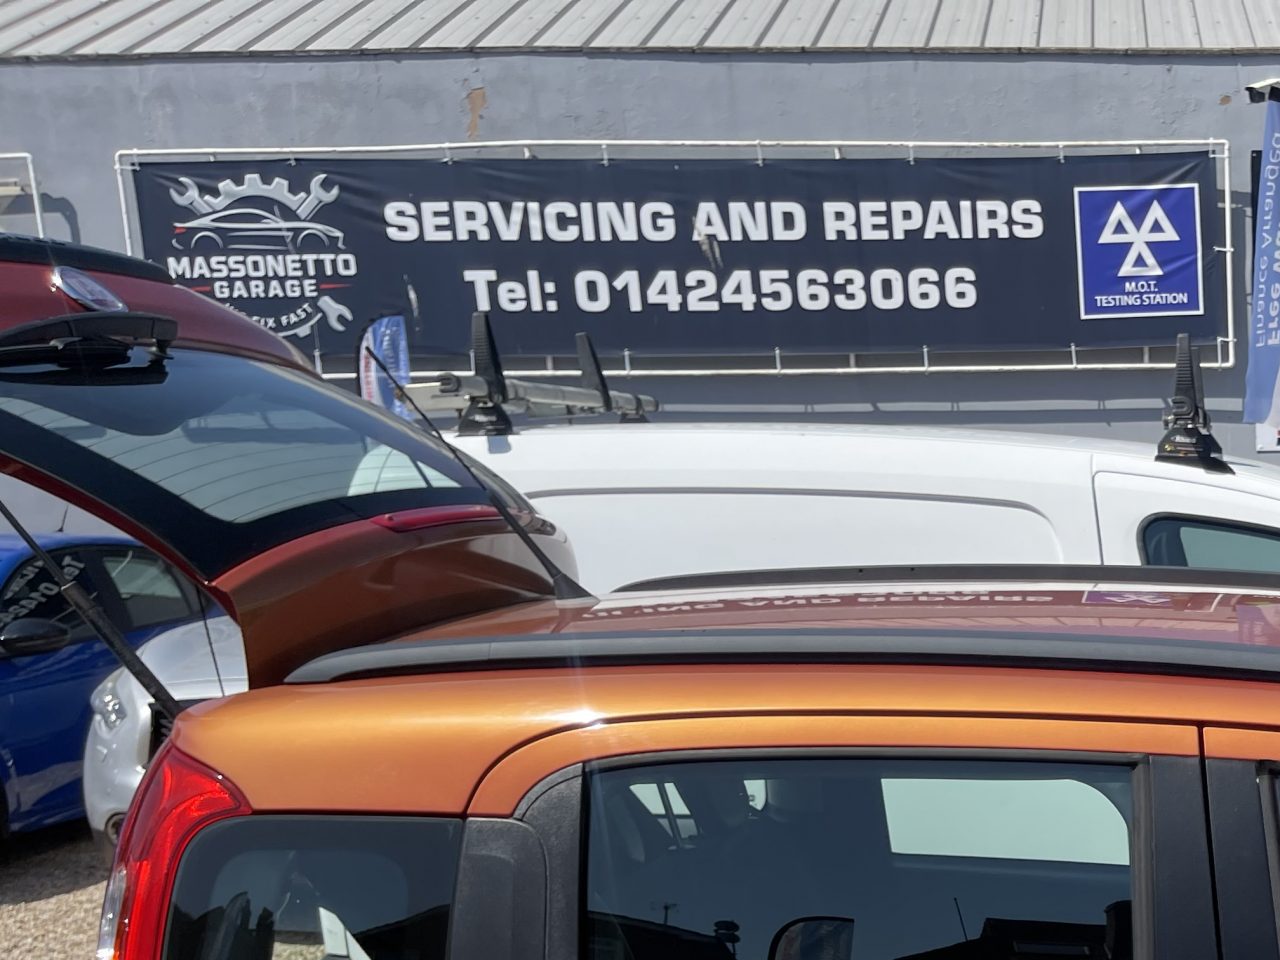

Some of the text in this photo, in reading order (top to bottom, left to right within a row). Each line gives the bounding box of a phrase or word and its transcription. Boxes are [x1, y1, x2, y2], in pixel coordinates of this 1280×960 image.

[384, 198, 1044, 243] SERVICING AND REPAIRS
[167, 253, 358, 280] MASSONETTO
[213, 279, 319, 299] GARAGE
[463, 267, 978, 314] Tel: 01424563066
[1094, 292, 1189, 308] TESTING STATION
[280, 303, 313, 327] FAST
